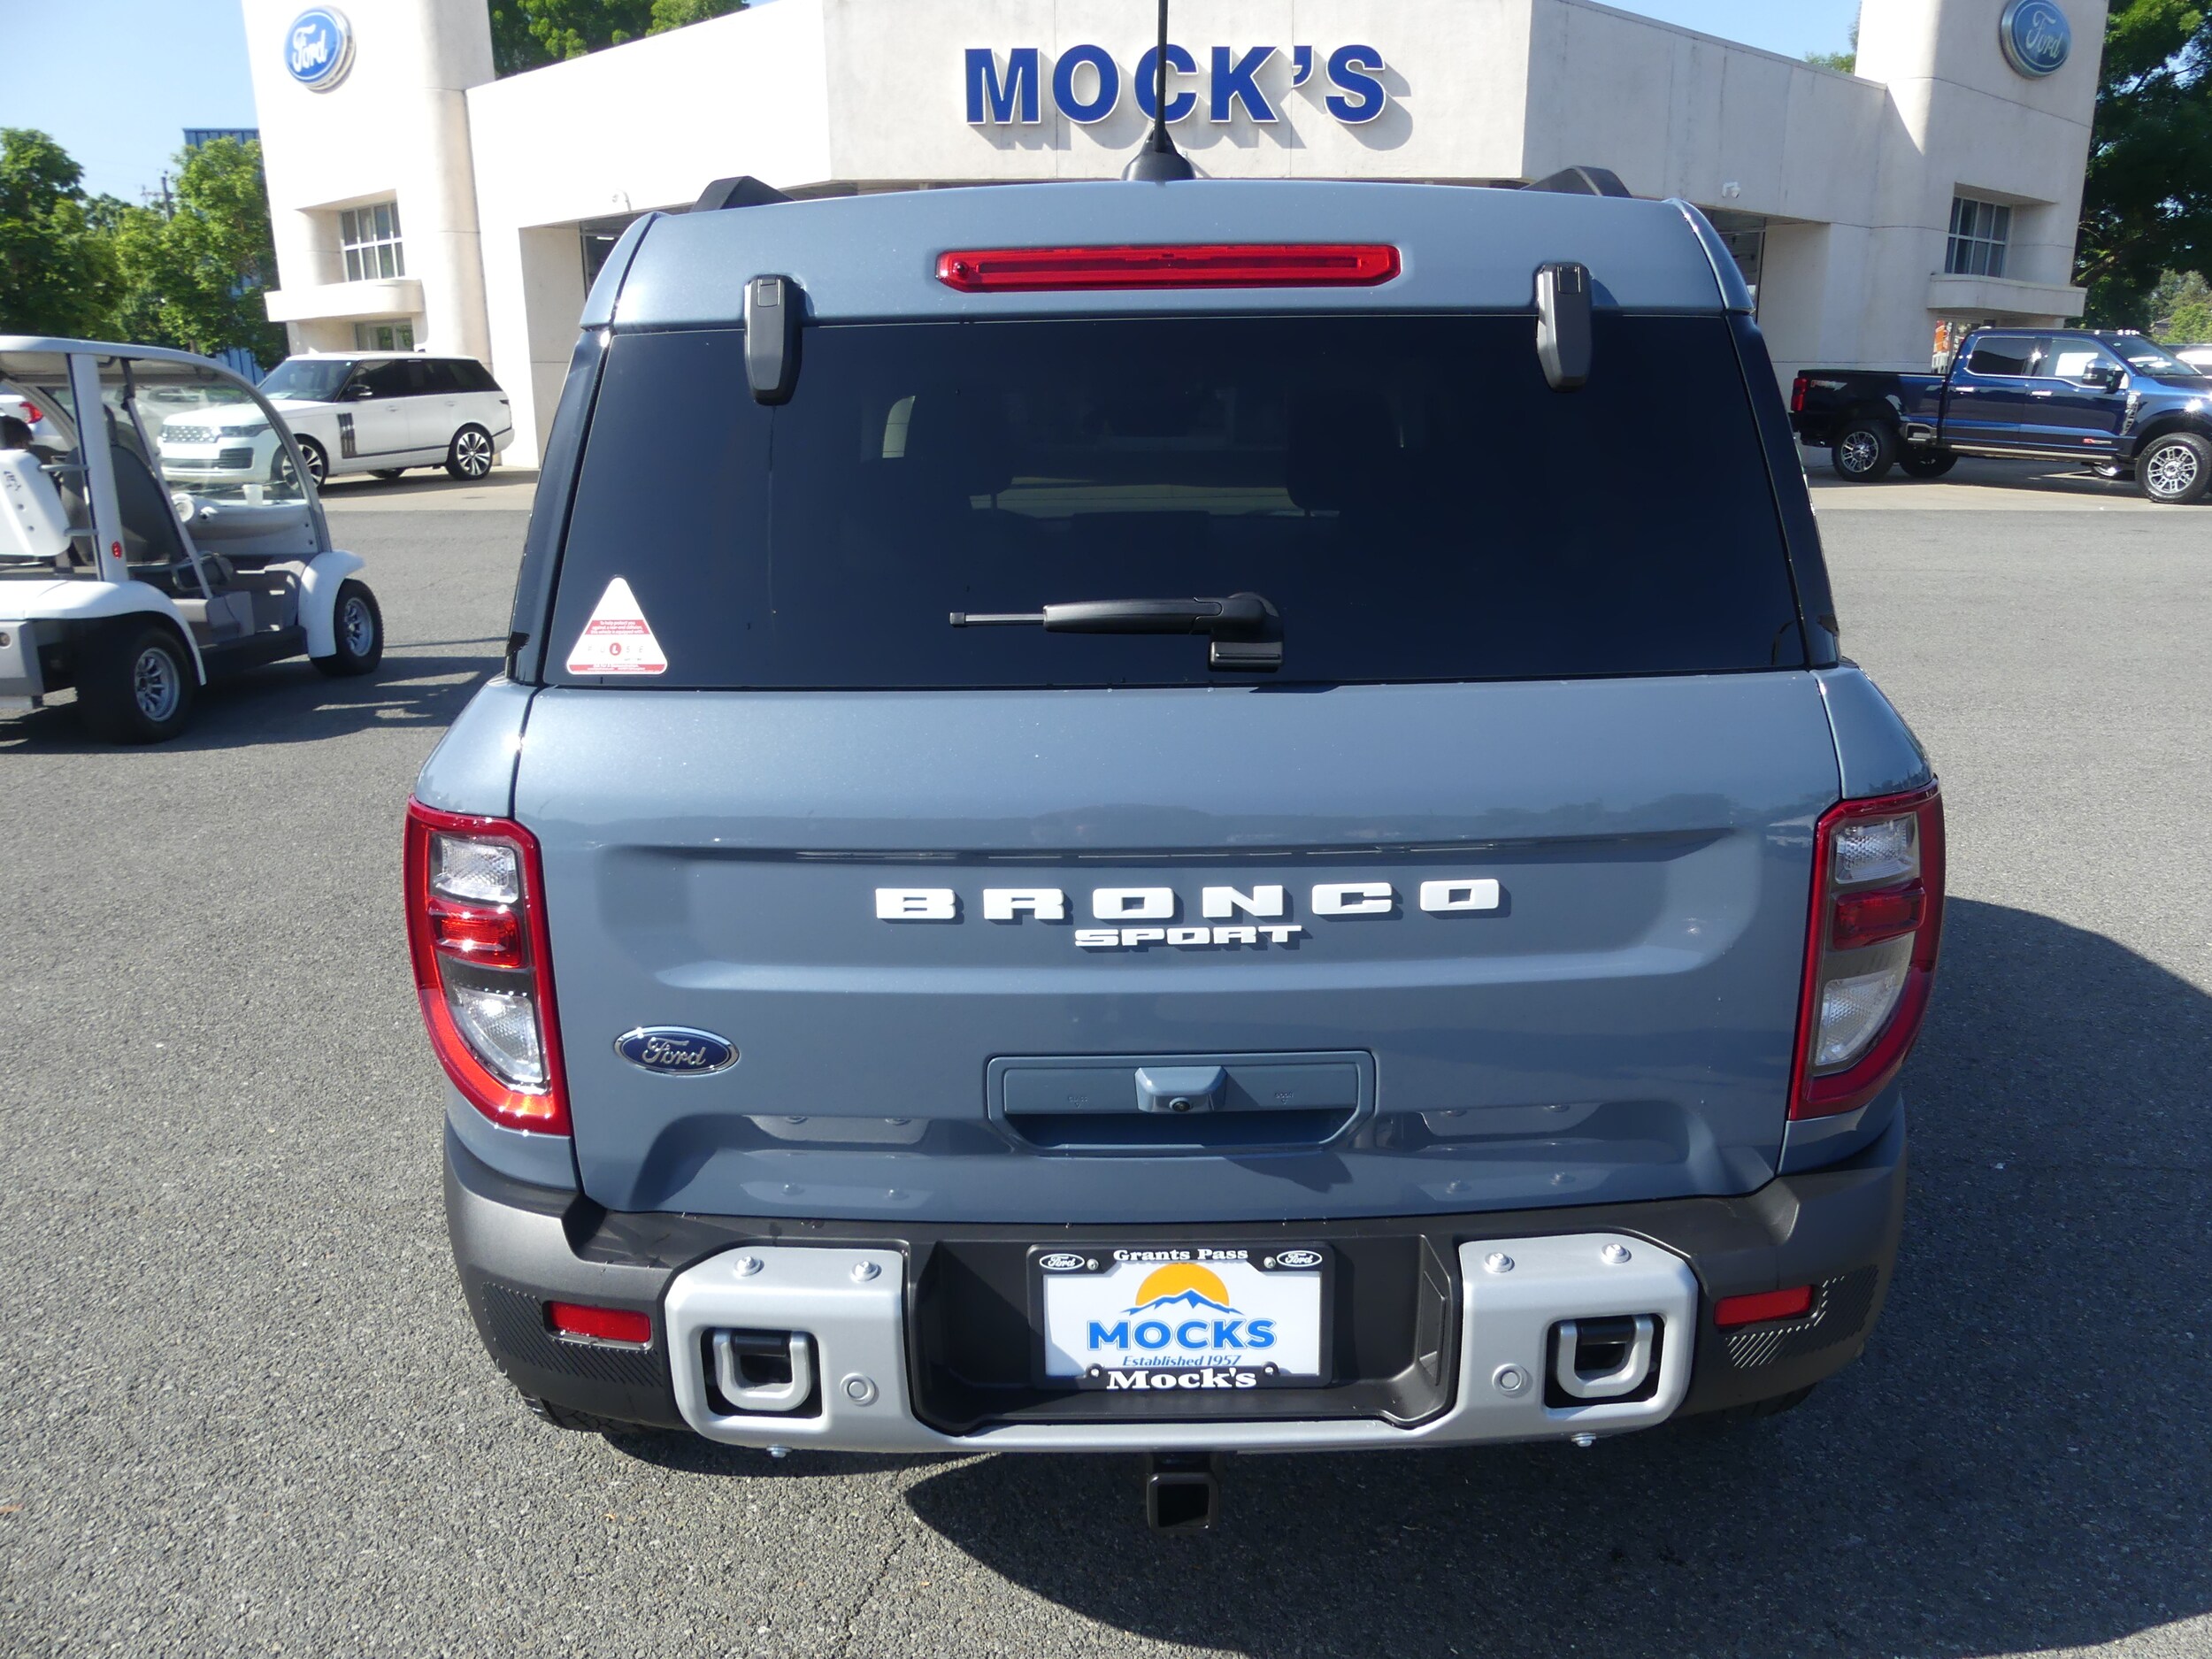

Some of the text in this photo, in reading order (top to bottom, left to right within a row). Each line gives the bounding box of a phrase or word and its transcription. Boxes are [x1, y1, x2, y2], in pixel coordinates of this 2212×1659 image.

[2025, 10, 2063, 59] Ford
[292, 23, 328, 73] Ford
[964, 44, 1386, 125] MOCK'S
[875, 879, 1500, 920] BRONCO
[1074, 925, 1302, 948] SPORT
[641, 1036, 707, 1065] Ford
[1048, 1256, 1077, 1267] Ford
[1113, 1248, 1248, 1261] Grants Pass
[1285, 1253, 1314, 1264] Ford
[1087, 1318, 1277, 1351] MOCKS
[1123, 1355, 1242, 1366] Established 1957
[1106, 1367, 1257, 1390] Mock's
